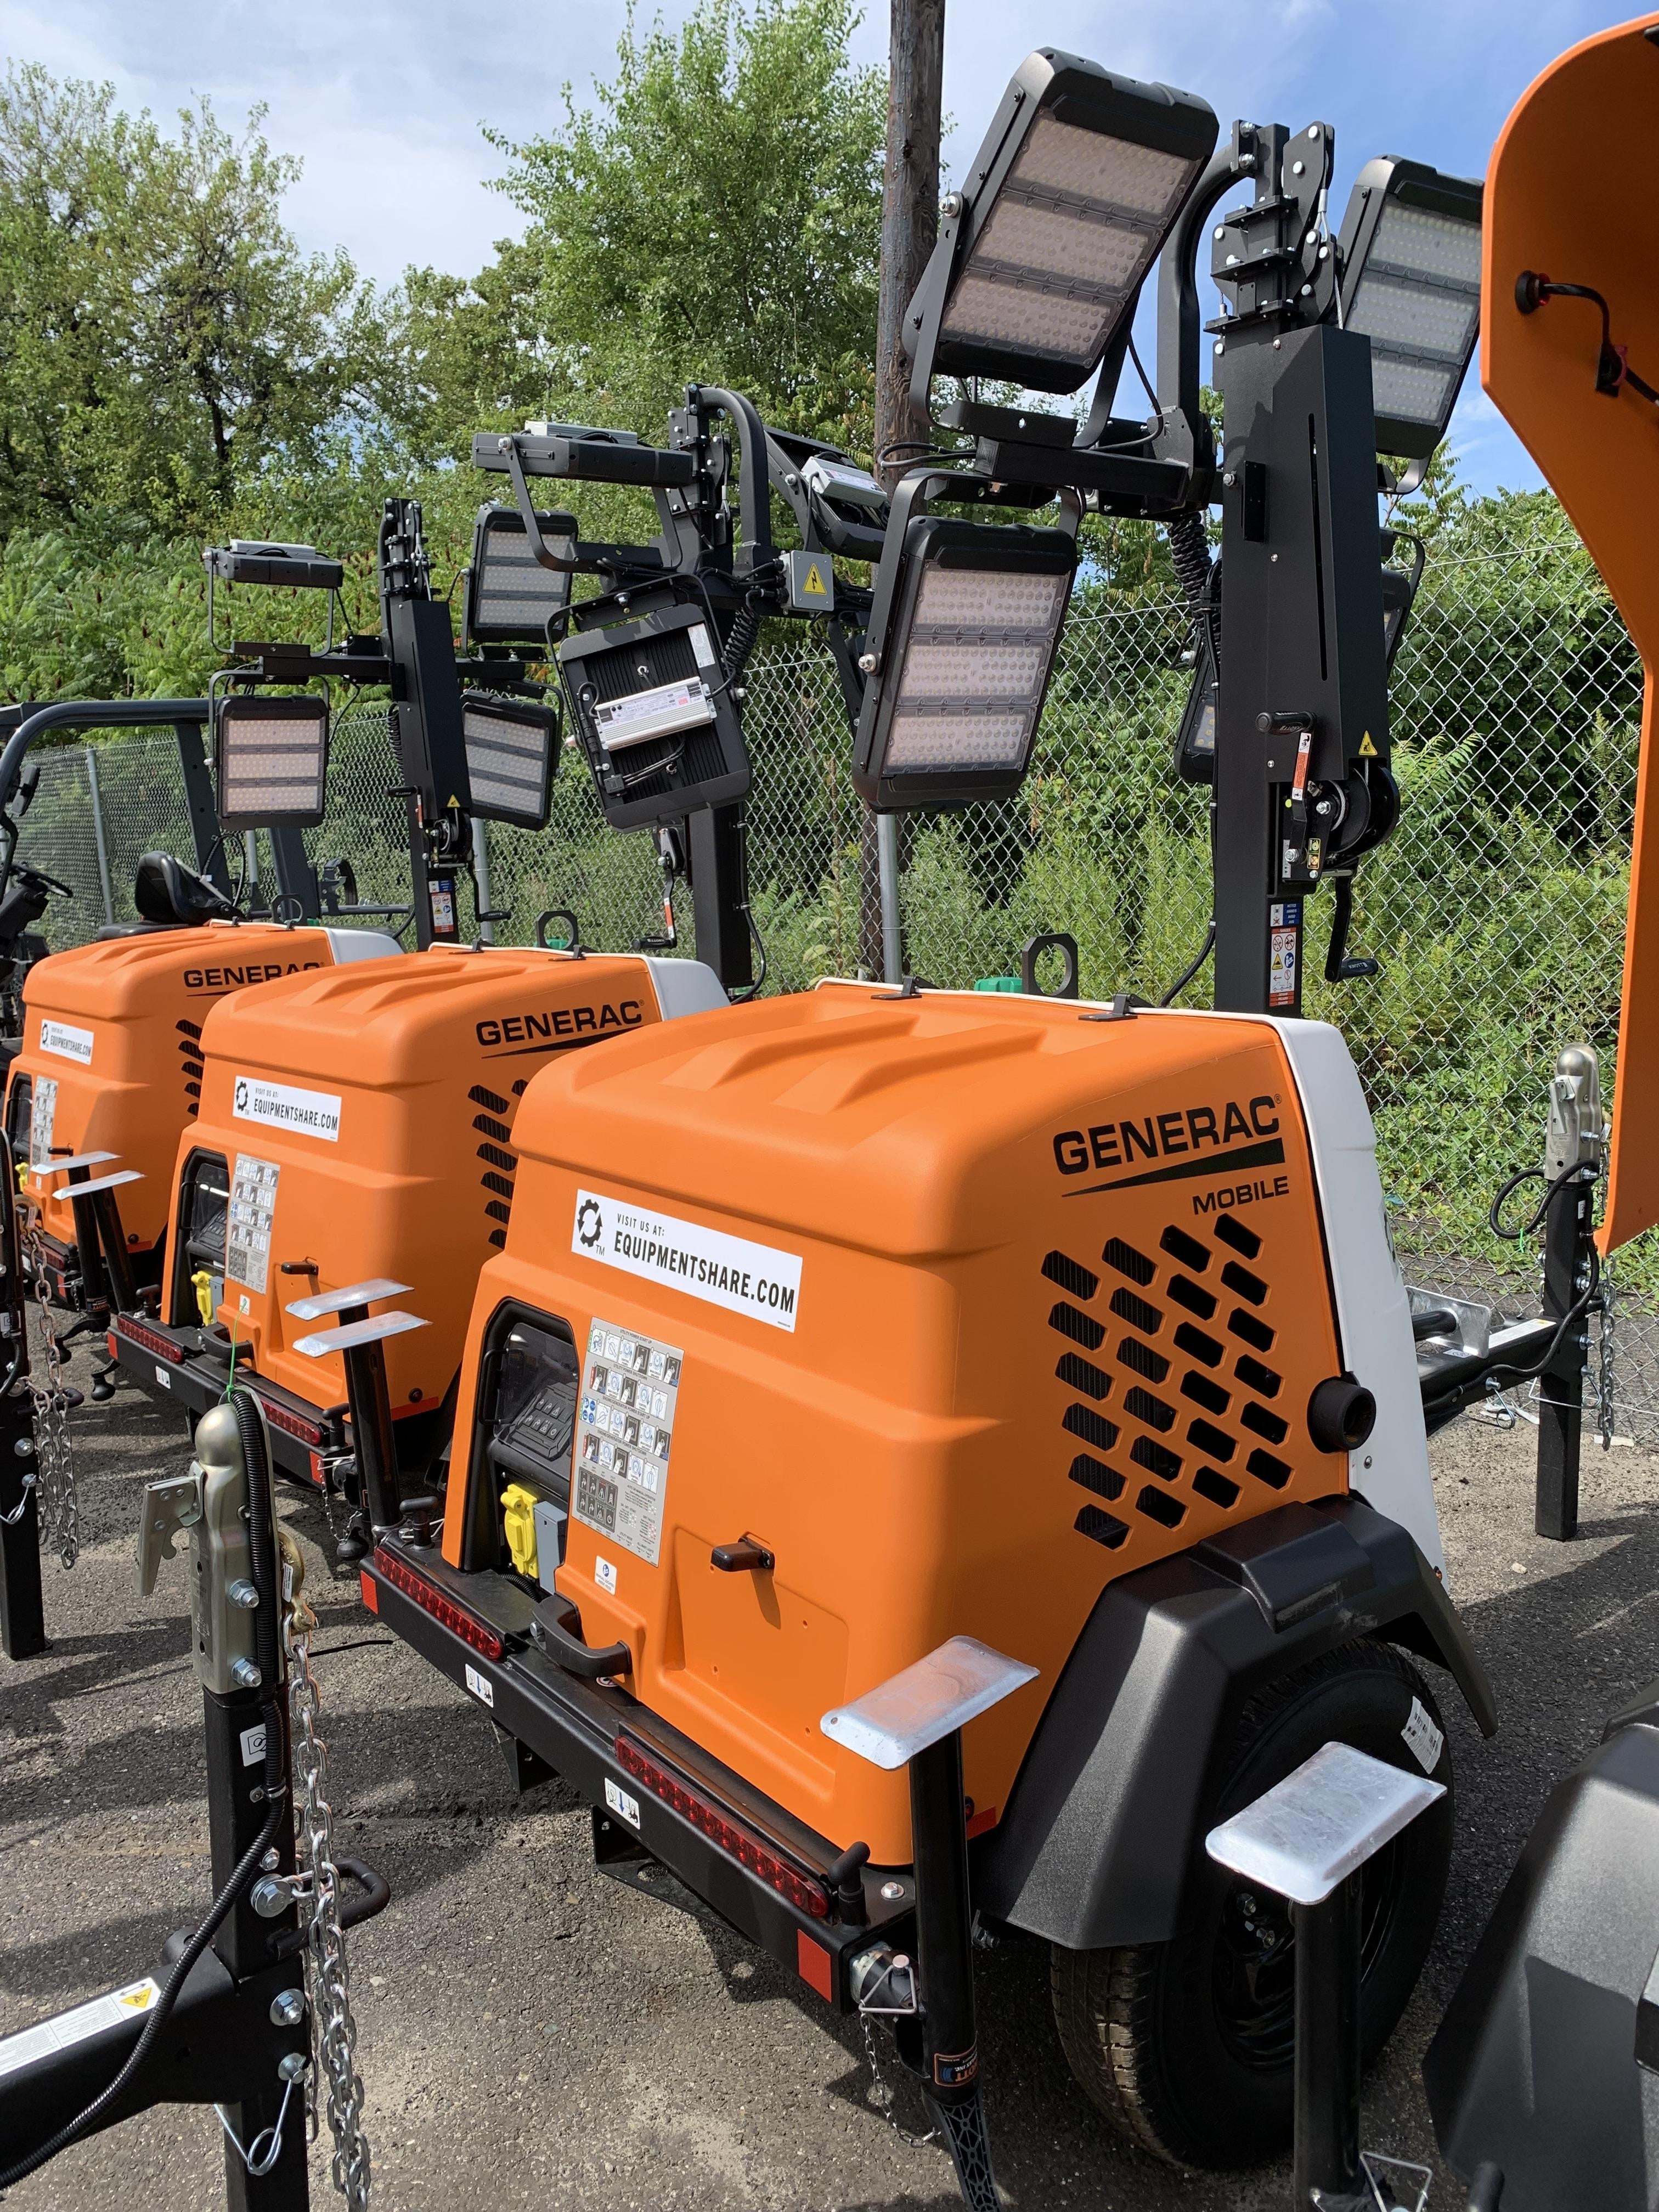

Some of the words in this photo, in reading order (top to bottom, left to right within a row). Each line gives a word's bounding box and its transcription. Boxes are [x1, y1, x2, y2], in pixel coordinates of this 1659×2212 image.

[476, 1001, 642, 1046] GENERAC
[50, 1035, 92, 1057] EQUIPMENTSHARE.COM
[253, 1098, 338, 1131] EQUIPMENTSHARE.COM
[1052, 1096, 1280, 1175] GENERAC
[1193, 1176, 1290, 1215] MOBILE
[617, 1213, 636, 1228] VISIT
[640, 1221, 650, 1232] US
[653, 1224, 665, 1237] AT:
[596, 1244, 605, 1256] TM
[614, 1231, 794, 1313] EQUIPMENTSHARE.COM
